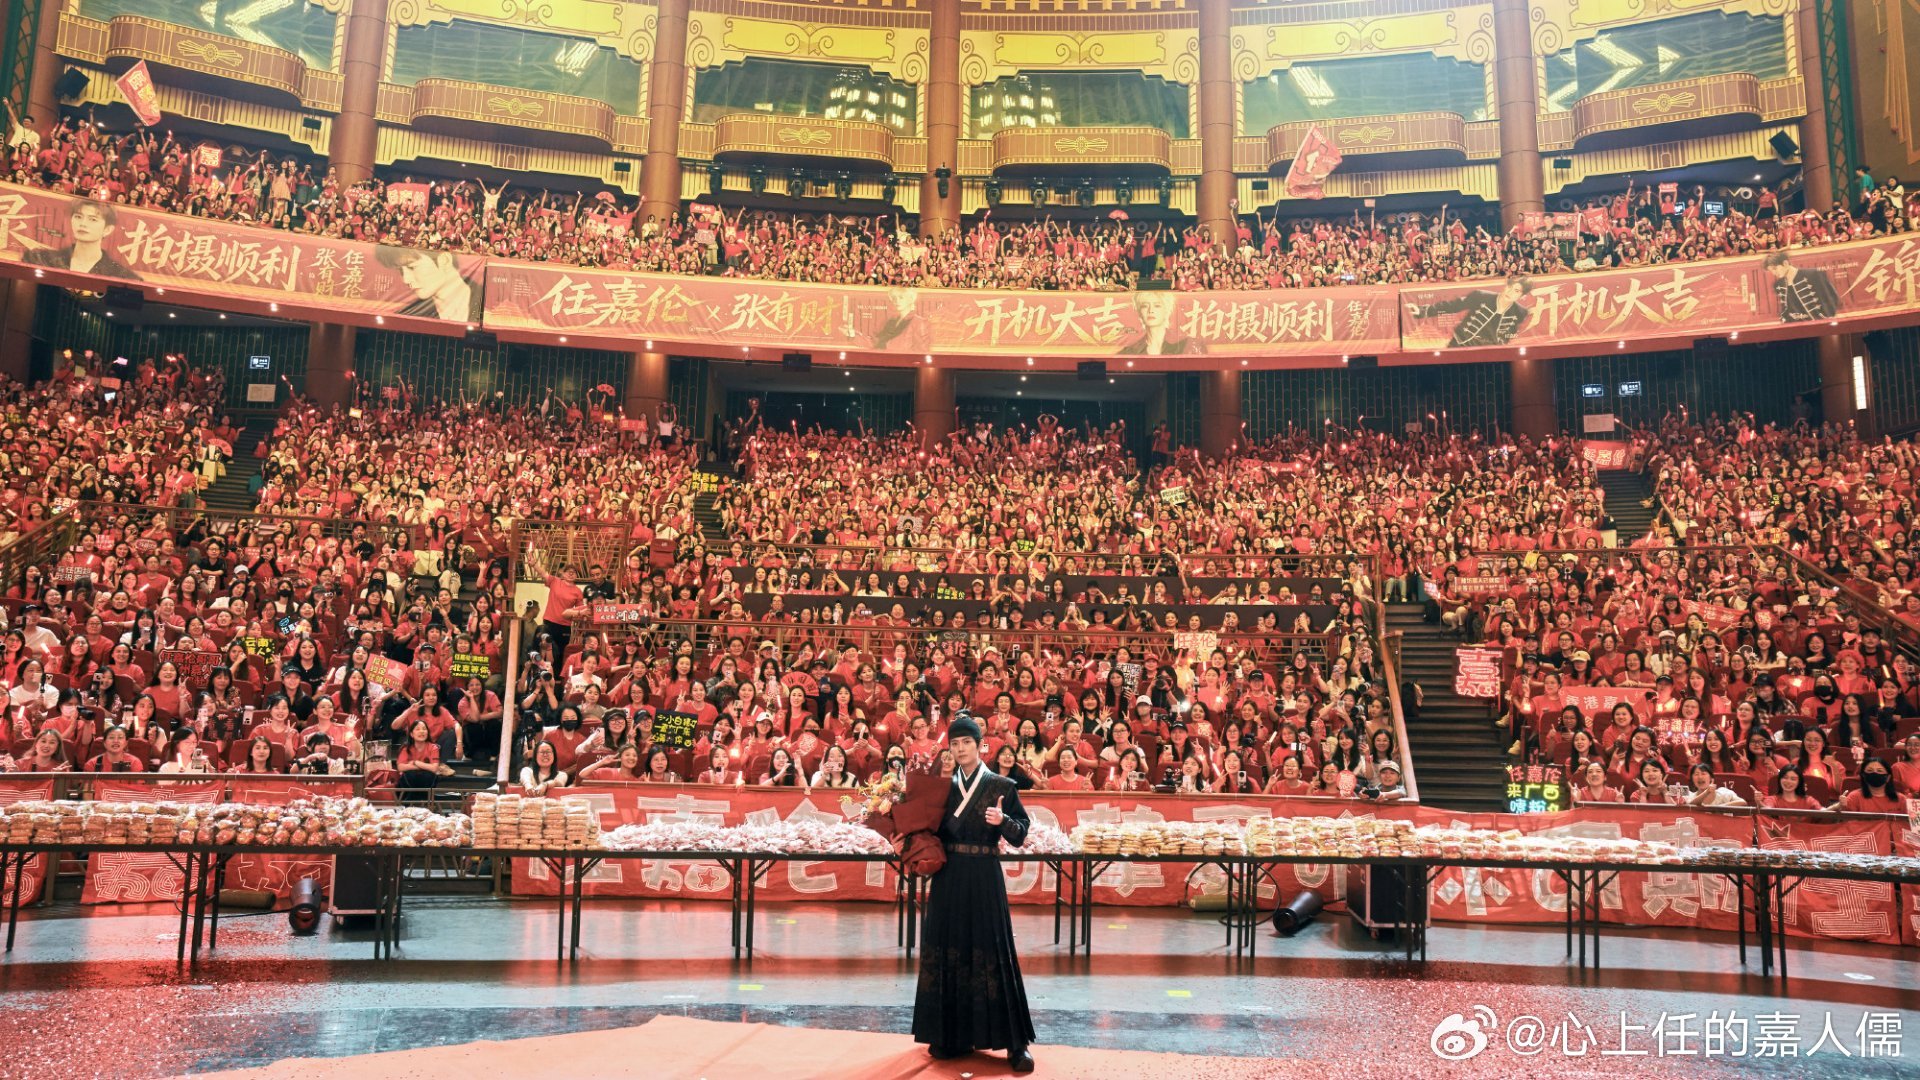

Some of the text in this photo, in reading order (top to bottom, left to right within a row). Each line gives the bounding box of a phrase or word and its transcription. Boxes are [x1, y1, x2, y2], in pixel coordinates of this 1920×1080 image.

[117, 218, 301, 292] 拍摄顺利
[309, 247, 341, 297] 张有财
[341, 248, 366, 298] 任嘉伦
[528, 273, 703, 328] 任嘉伦
[713, 290, 841, 336] 张有财
[961, 296, 1130, 347] 开机大吉
[1180, 297, 1334, 342] 拍摄顺利
[1523, 268, 1721, 337] 开机大吉
[245, 637, 269, 648] 云南
[1174, 632, 1216, 648] 任嘉伦
[452, 663, 489, 674] 北京等你
[1455, 646, 1503, 698] 嘉
[1658, 718, 1707, 732] 新疆嘉人
[1507, 783, 1560, 799] 来广西
[1509, 765, 1561, 784] 任嘉伦
